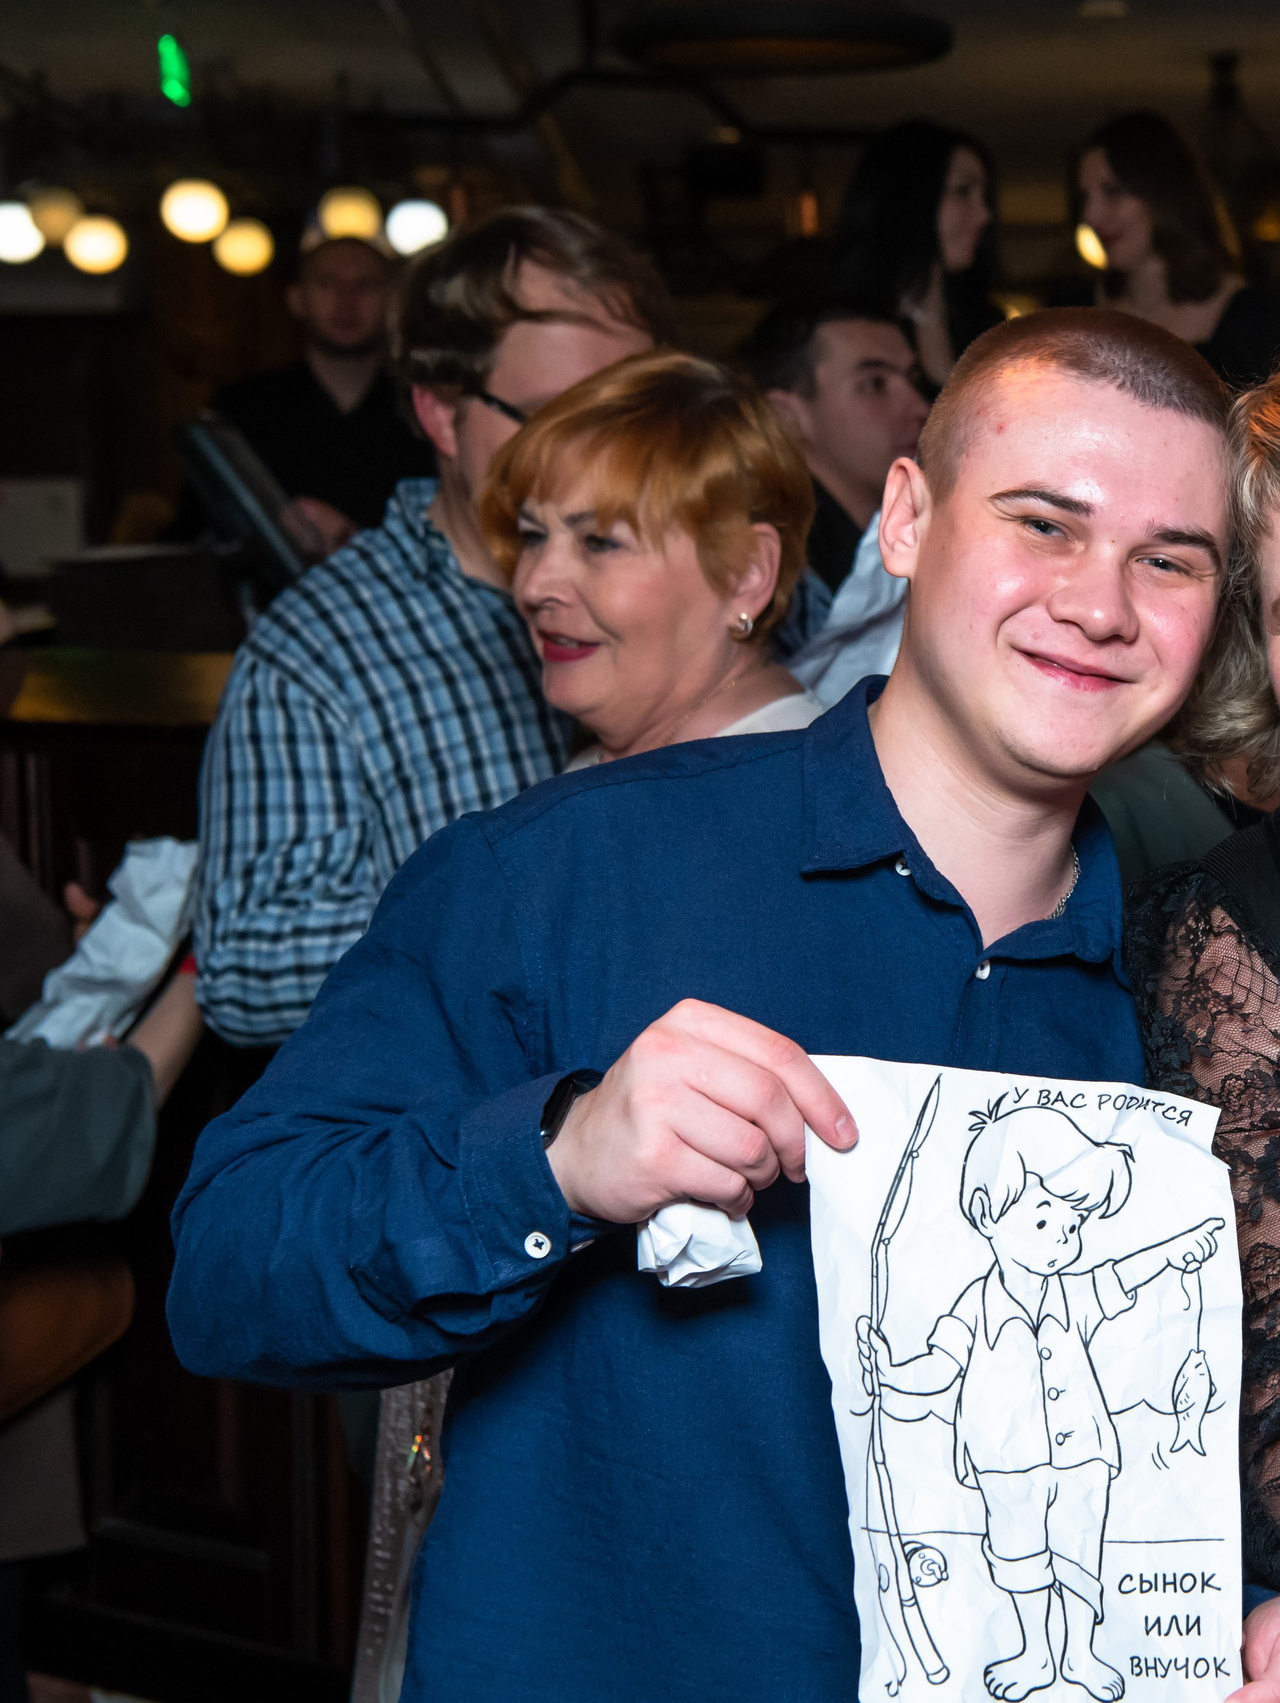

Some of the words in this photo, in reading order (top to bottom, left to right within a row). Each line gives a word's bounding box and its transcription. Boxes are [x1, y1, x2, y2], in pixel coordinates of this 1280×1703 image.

[1013, 1086, 1030, 1104] У
[1036, 1089, 1088, 1109] ВАС
[1097, 1093, 1194, 1127] РОДИТСЯ
[1117, 1571, 1222, 1595] СЫНОК
[1144, 1614, 1202, 1637] ИЛИ
[1129, 1655, 1231, 1680] ВНУЧОК
